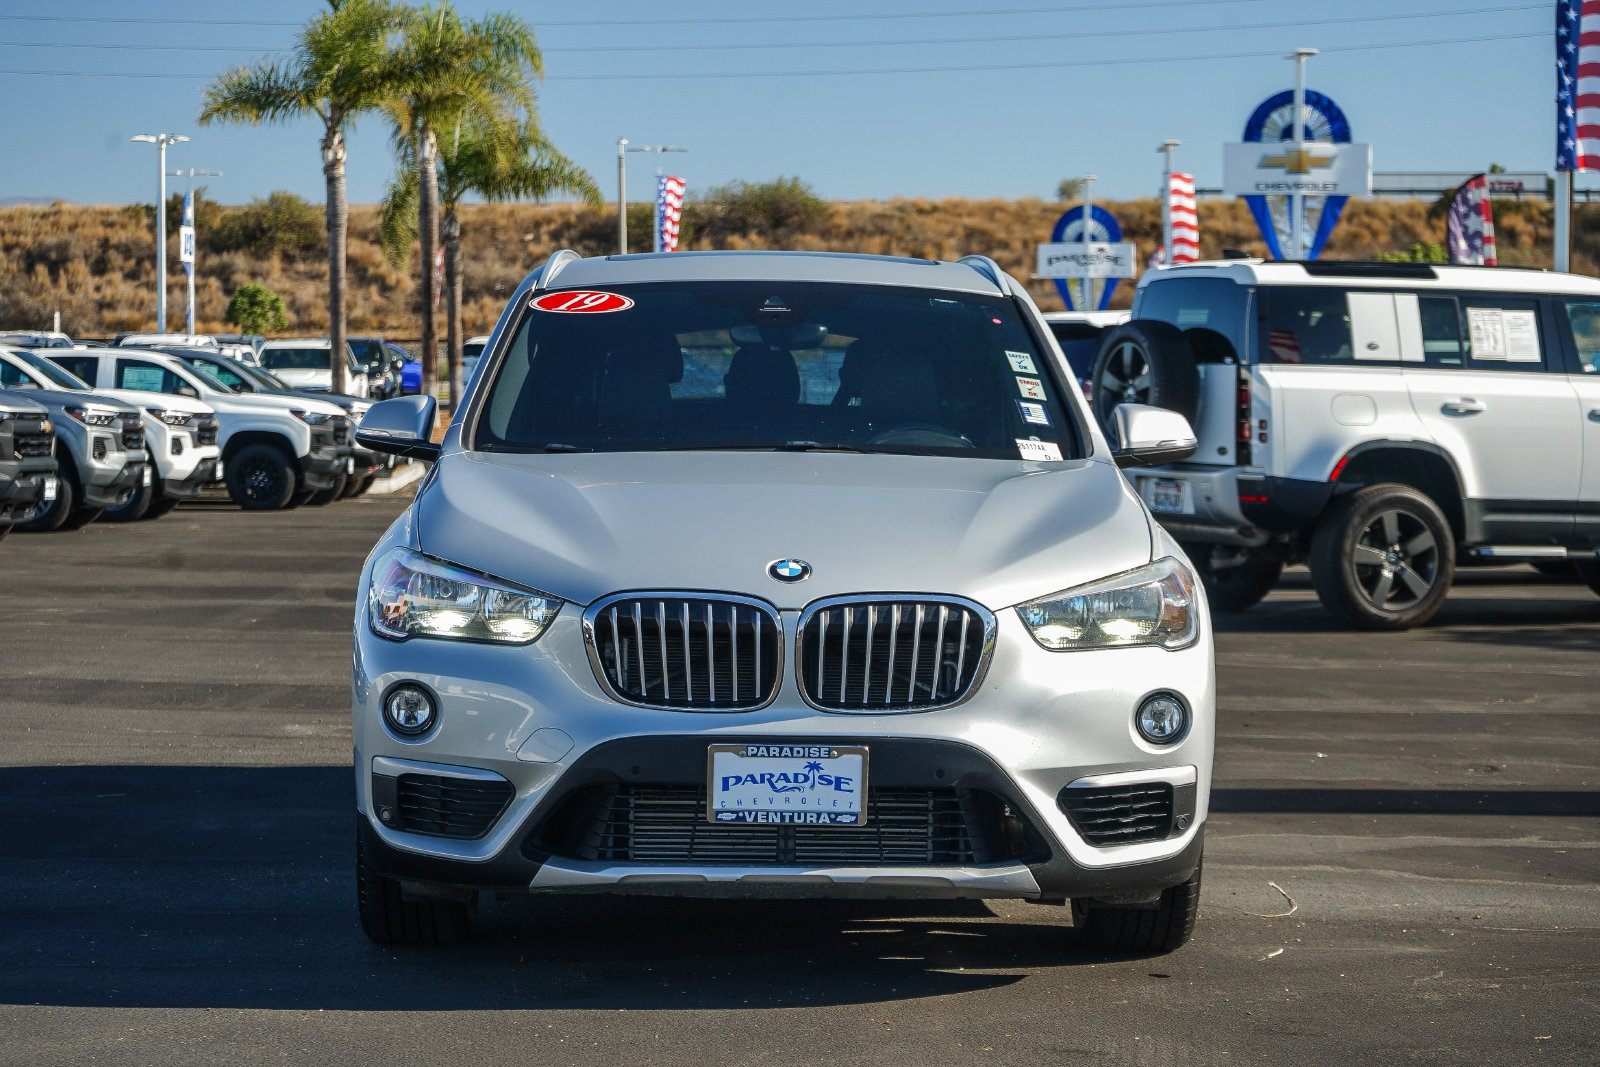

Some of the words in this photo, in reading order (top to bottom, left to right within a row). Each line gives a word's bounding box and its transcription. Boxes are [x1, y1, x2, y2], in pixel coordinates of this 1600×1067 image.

[1255, 181, 1339, 192] CHEVROLET
[551, 293, 610, 311] 19
[1018, 379, 1040, 387] SMOG
[747, 746, 830, 758] PARADISE
[721, 761, 854, 793] PARADISE
[720, 797, 854, 810] CHEVROLET
[744, 811, 831, 824] VENTURA
